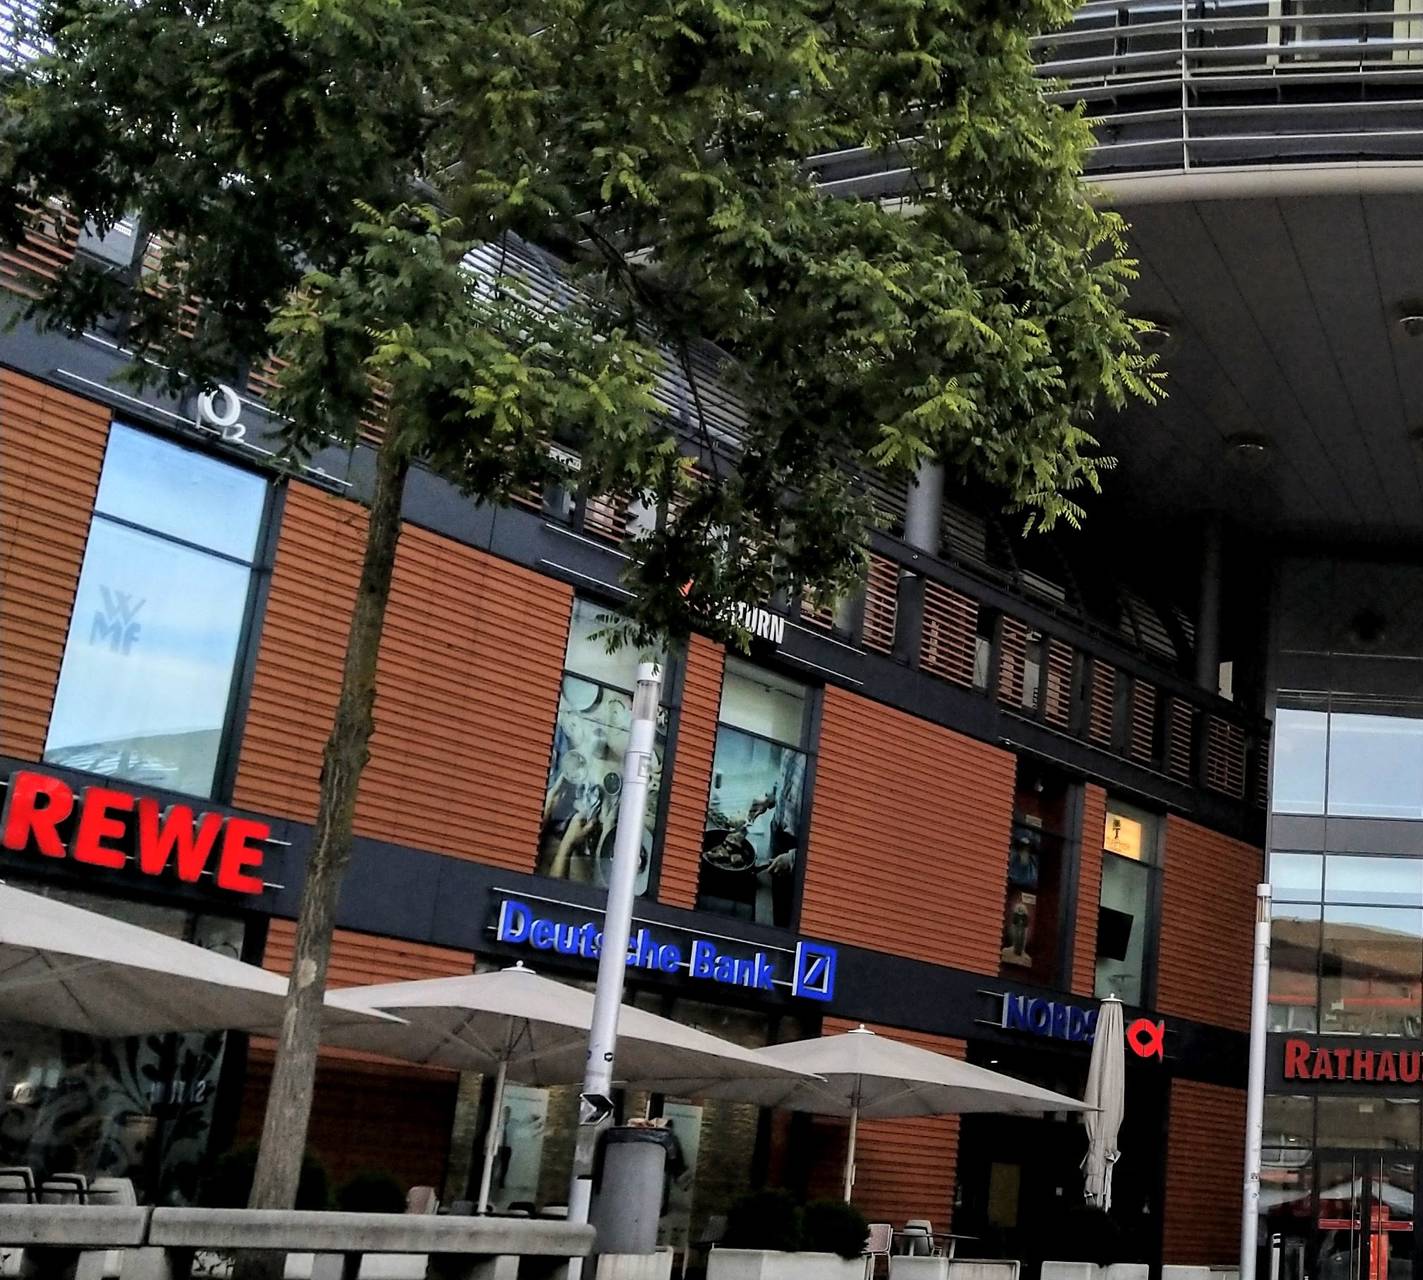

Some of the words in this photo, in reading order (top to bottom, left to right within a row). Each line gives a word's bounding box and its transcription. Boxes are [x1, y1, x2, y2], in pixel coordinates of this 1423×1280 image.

[1, 770, 271, 895] REWE
[497, 899, 680, 973] Deutsche
[688, 940, 776, 990] Bank
[1002, 992, 1098, 1046] NORDS
